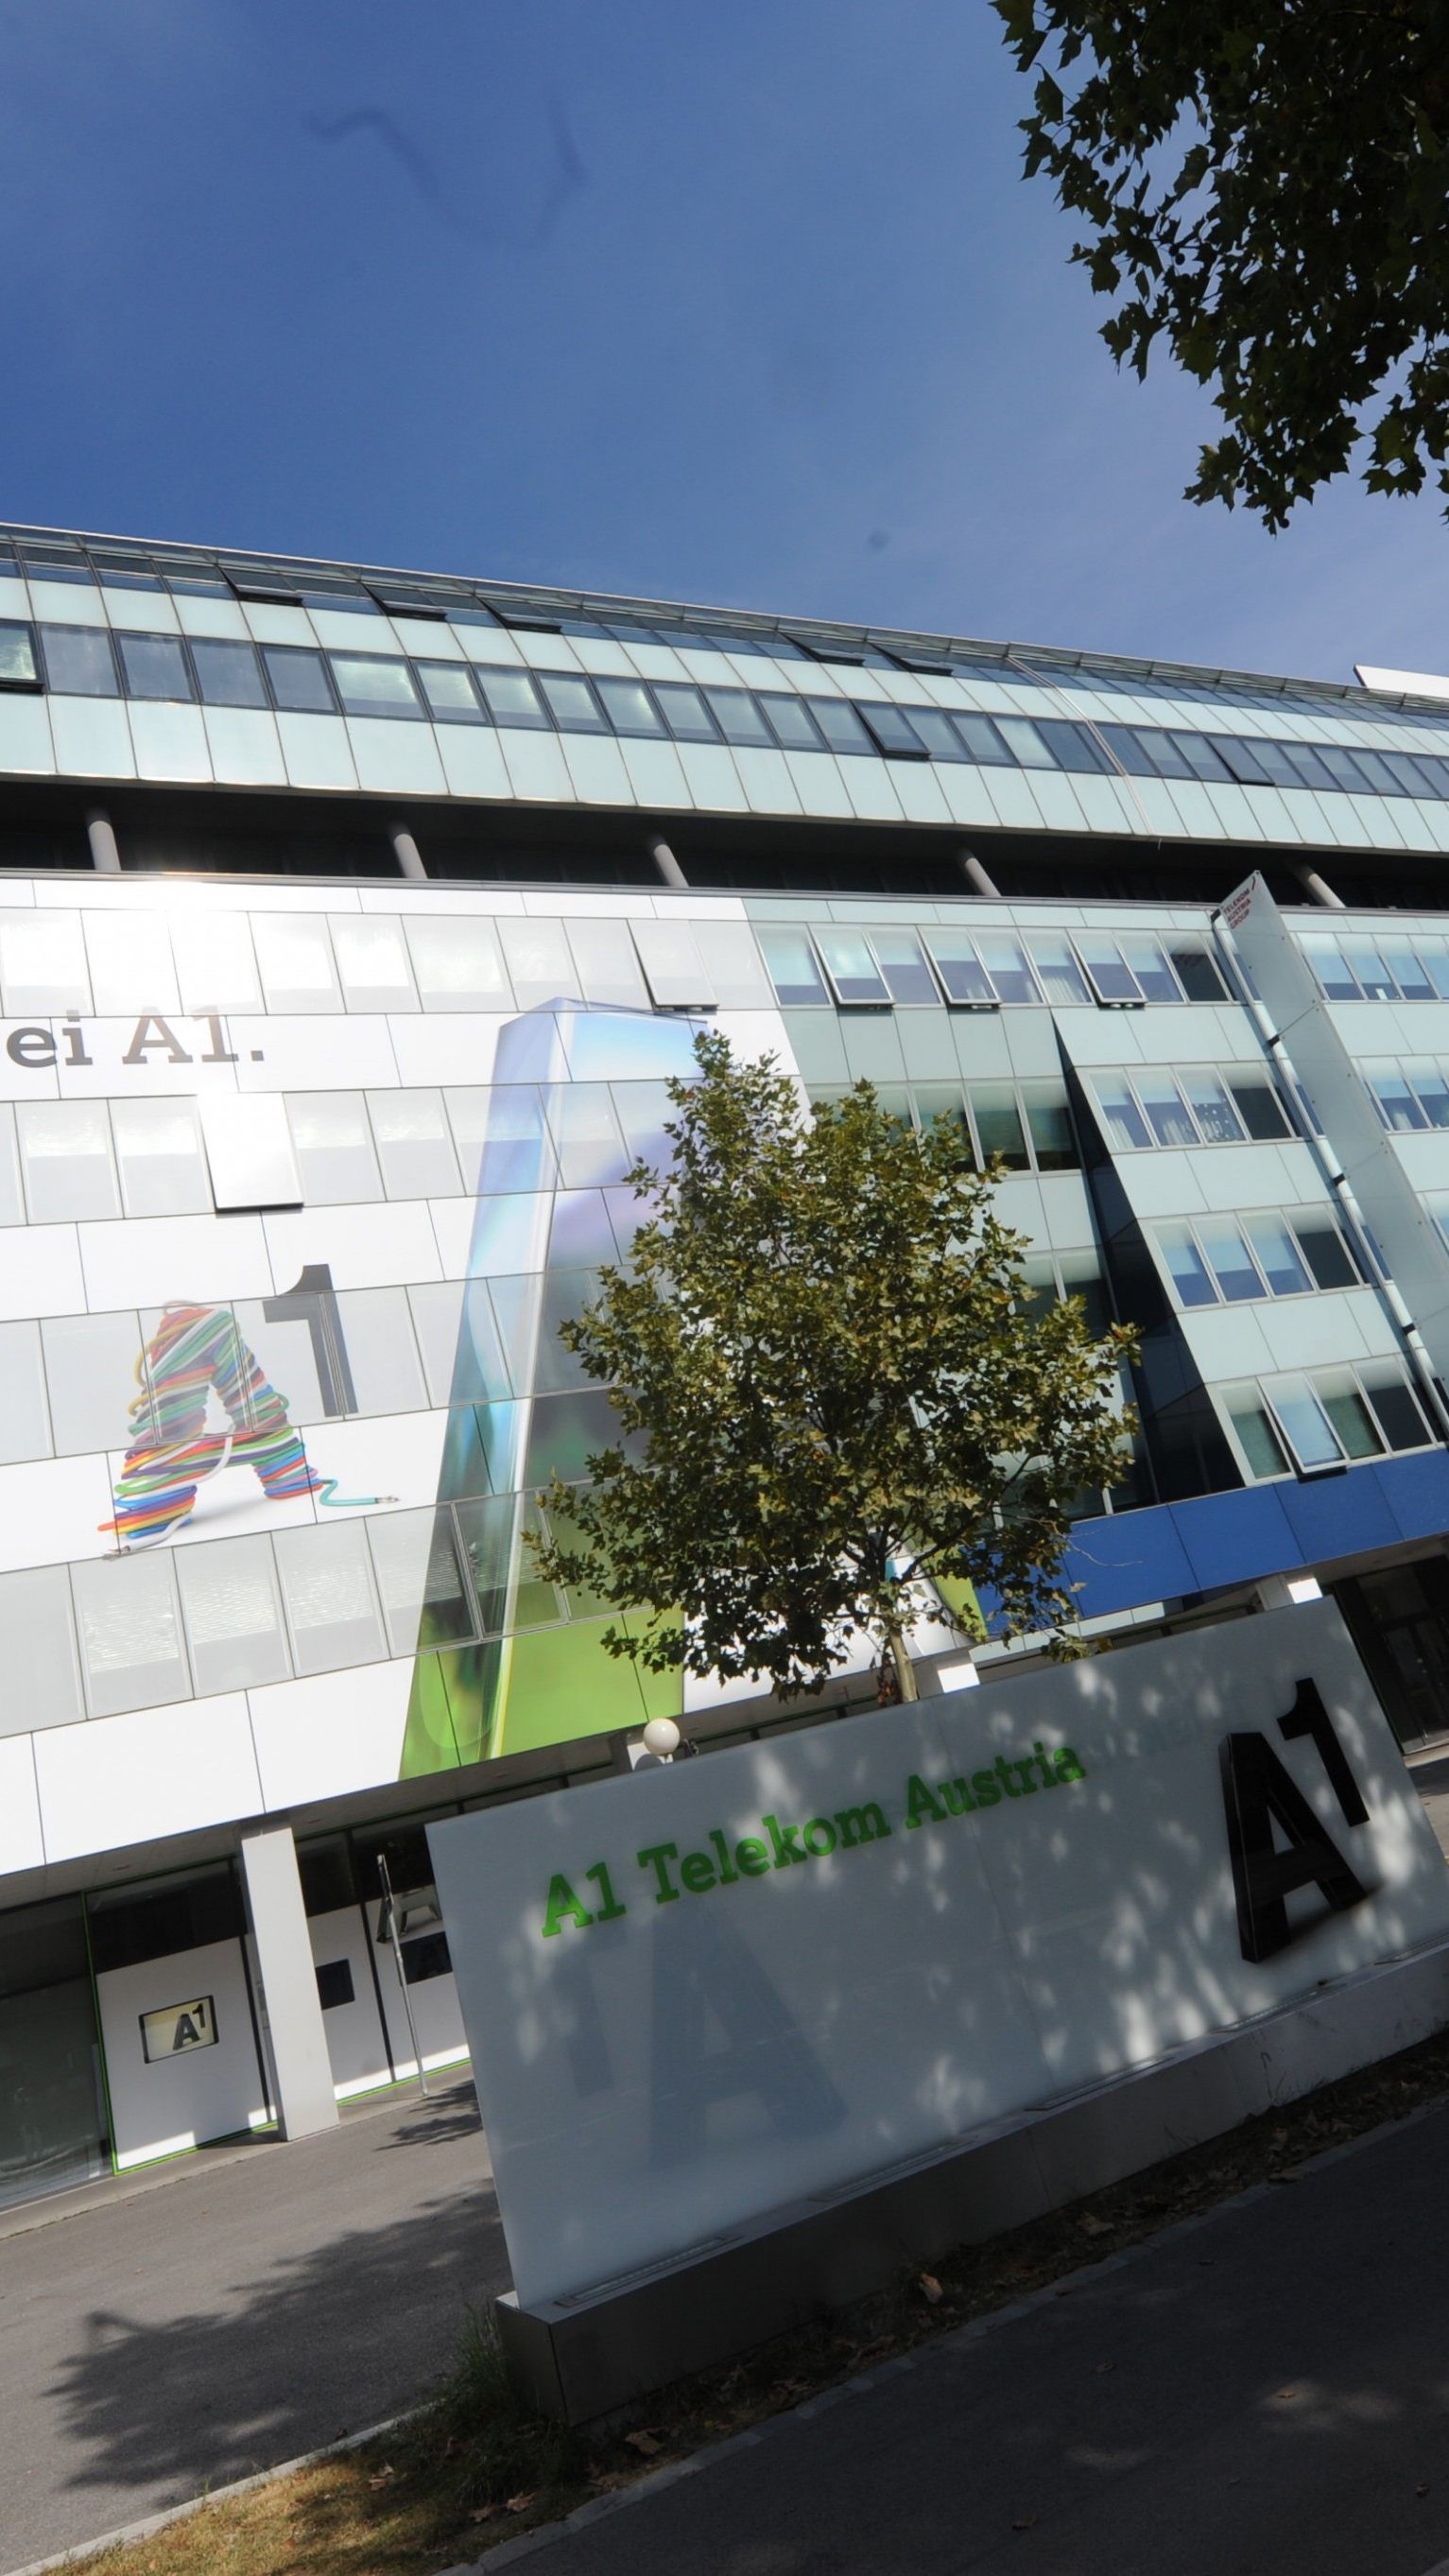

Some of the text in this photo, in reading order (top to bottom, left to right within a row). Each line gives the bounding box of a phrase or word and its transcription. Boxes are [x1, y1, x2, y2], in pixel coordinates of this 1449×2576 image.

[122, 1005, 265, 1064] A1.
[542, 1861, 626, 1937] A1
[637, 1796, 891, 1905] Telekom
[906, 1741, 1087, 1830] Austria
[1218, 1677, 1370, 1963] A1
[173, 2003, 207, 2049] A1
